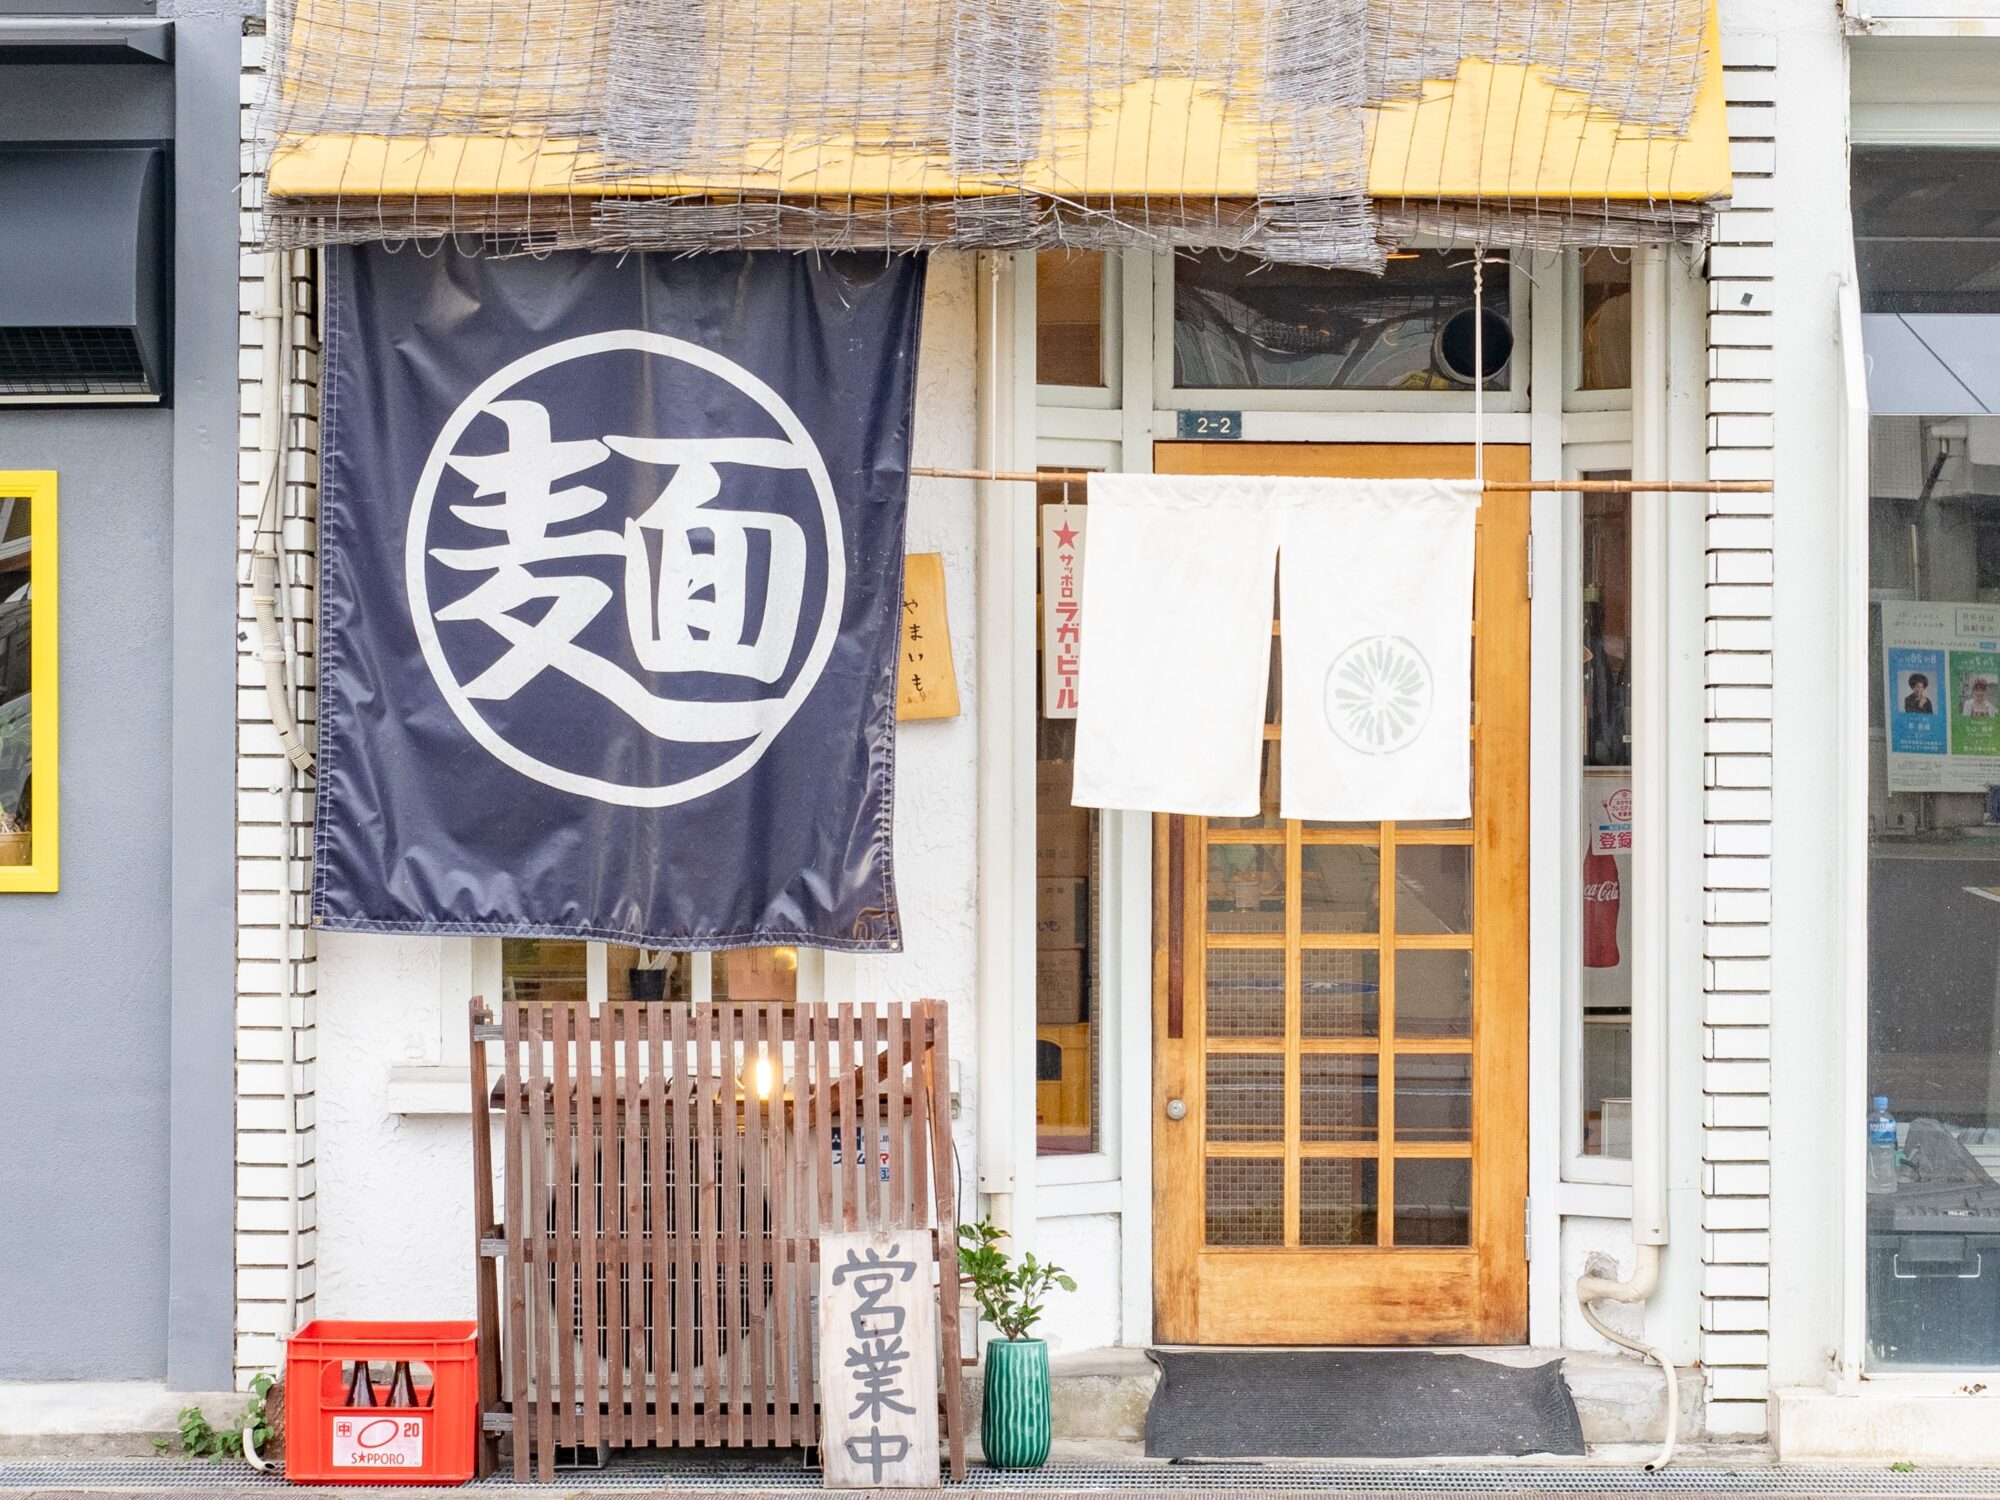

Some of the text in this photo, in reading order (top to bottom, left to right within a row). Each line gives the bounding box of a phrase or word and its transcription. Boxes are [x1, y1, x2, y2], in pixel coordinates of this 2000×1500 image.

[1197, 417, 1231, 433] 2-2
[428, 398, 812, 744] 麺
[832, 1243, 917, 1485] 営業中
[338, 1423, 350, 1437] 中
[403, 1422, 420, 1438] 20
